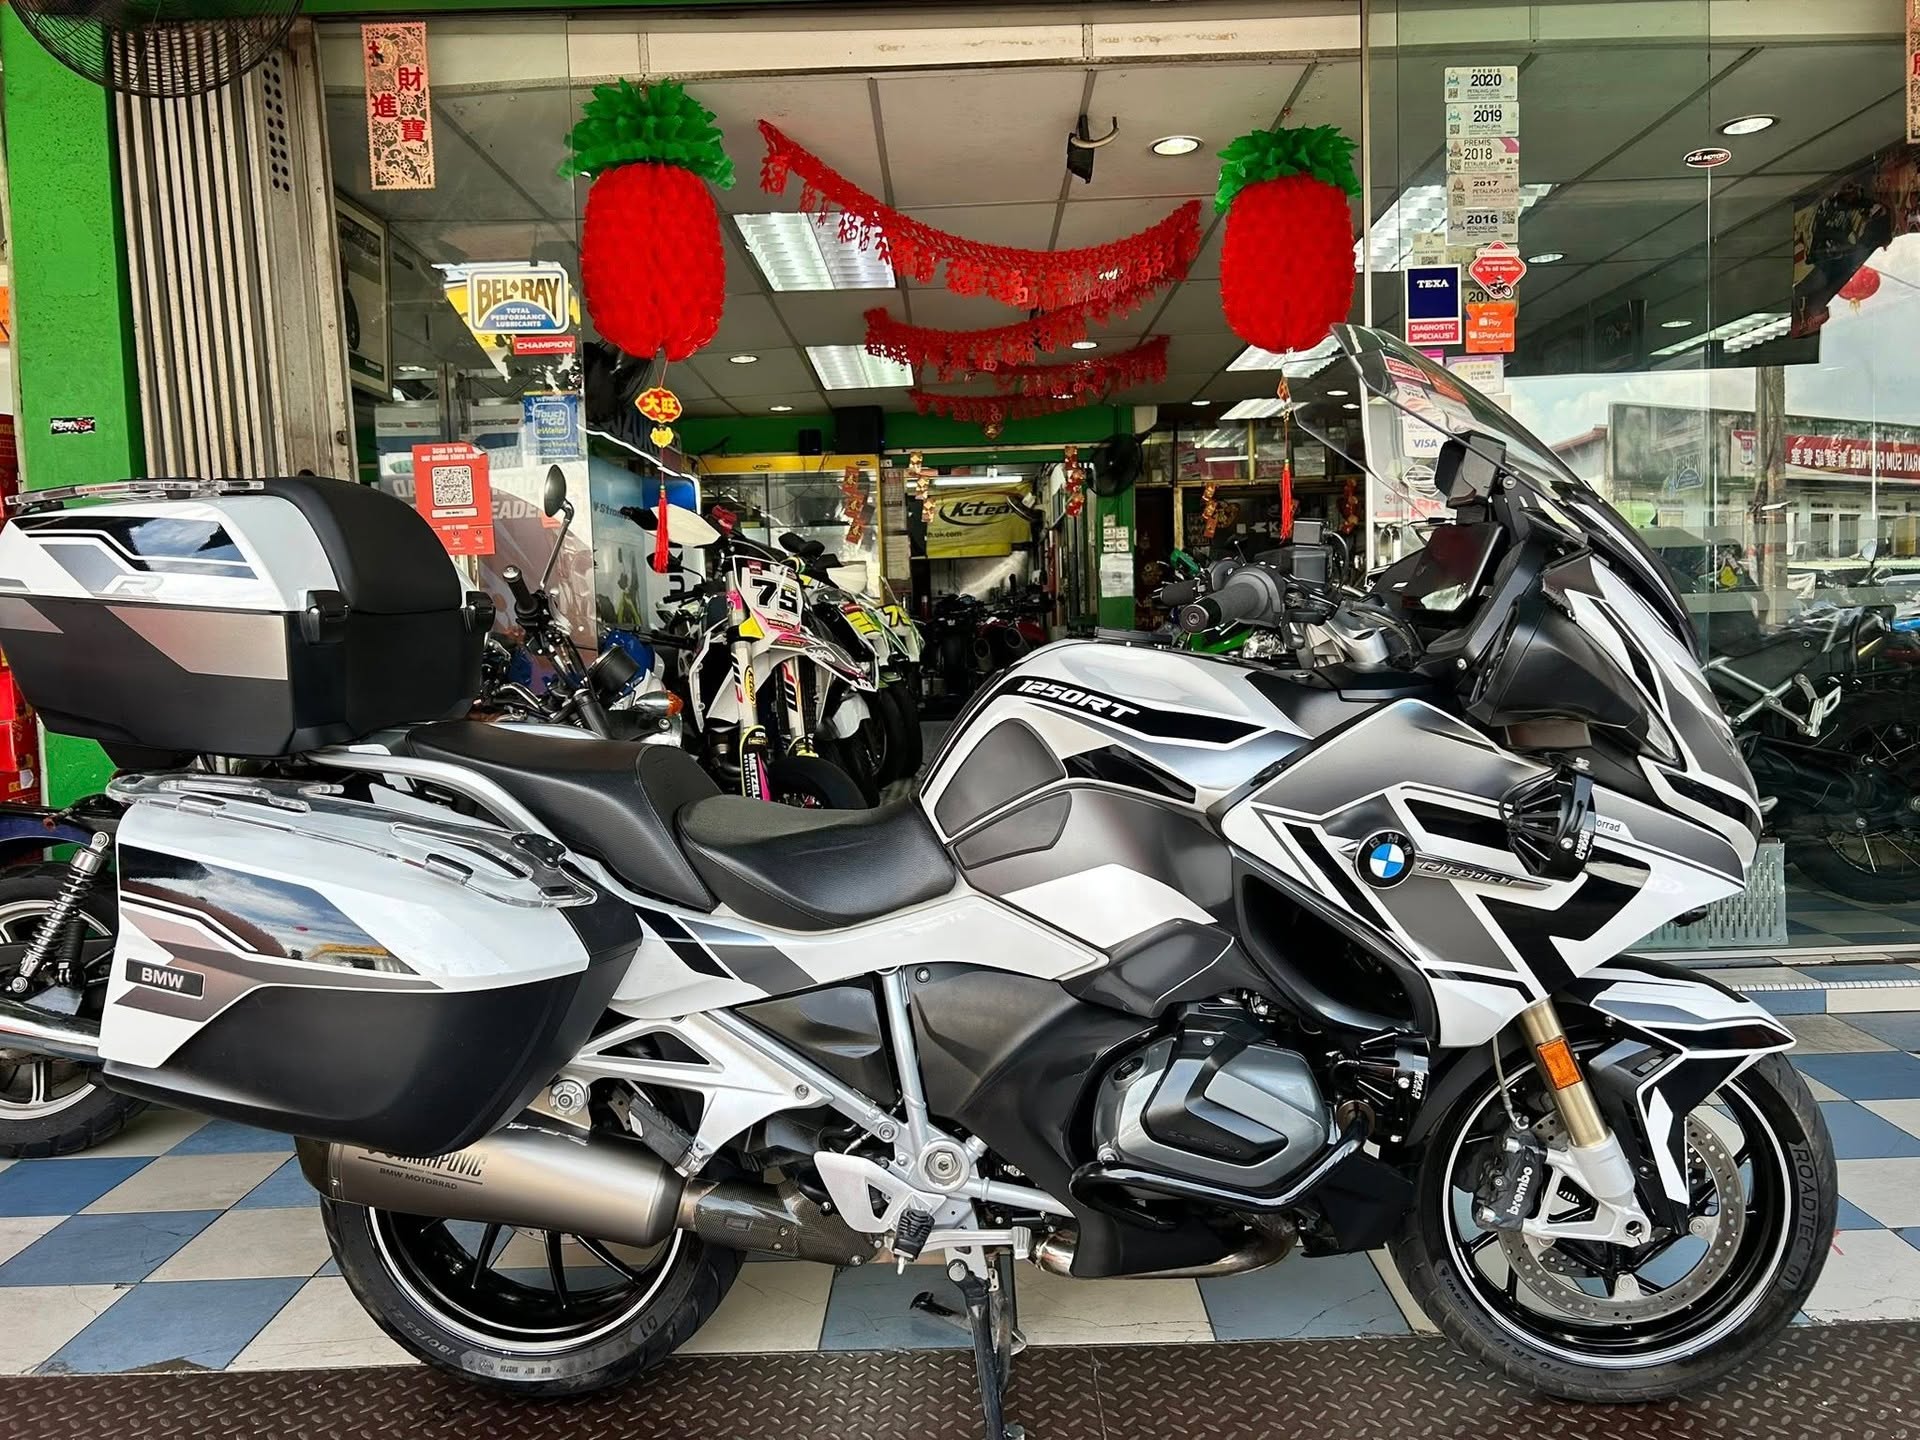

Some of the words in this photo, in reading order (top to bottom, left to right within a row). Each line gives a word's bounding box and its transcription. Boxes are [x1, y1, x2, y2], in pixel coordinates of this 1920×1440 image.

[1470, 73, 1502, 87] 2020
[1473, 109, 1503, 123] 2019
[1464, 147, 1493, 160] 2018
[1466, 214, 1498, 225] 2016
[1416, 279, 1449, 288] TEXA
[1411, 323, 1456, 332] DIAGNOSTIC
[1488, 318, 1502, 327] Pay
[1412, 332, 1455, 341] SPECIALIST
[516, 341, 575, 350] CHAMPION
[642, 394, 680, 415] 大旺
[1413, 438, 1438, 448] VISA
[751, 577, 800, 617] 75
[1017, 680, 1140, 718] 1250RT
[748, 753, 761, 800] METZEL
[1596, 819, 1622, 832] orrad
[1369, 832, 1413, 856] BMW
[141, 967, 184, 989] BMW
[378, 1167, 404, 1178] BMW
[404, 1173, 458, 1190] MOTORRAD
[1506, 1166, 1533, 1216] brembo
[1794, 1150, 1815, 1250] ROADTEC
